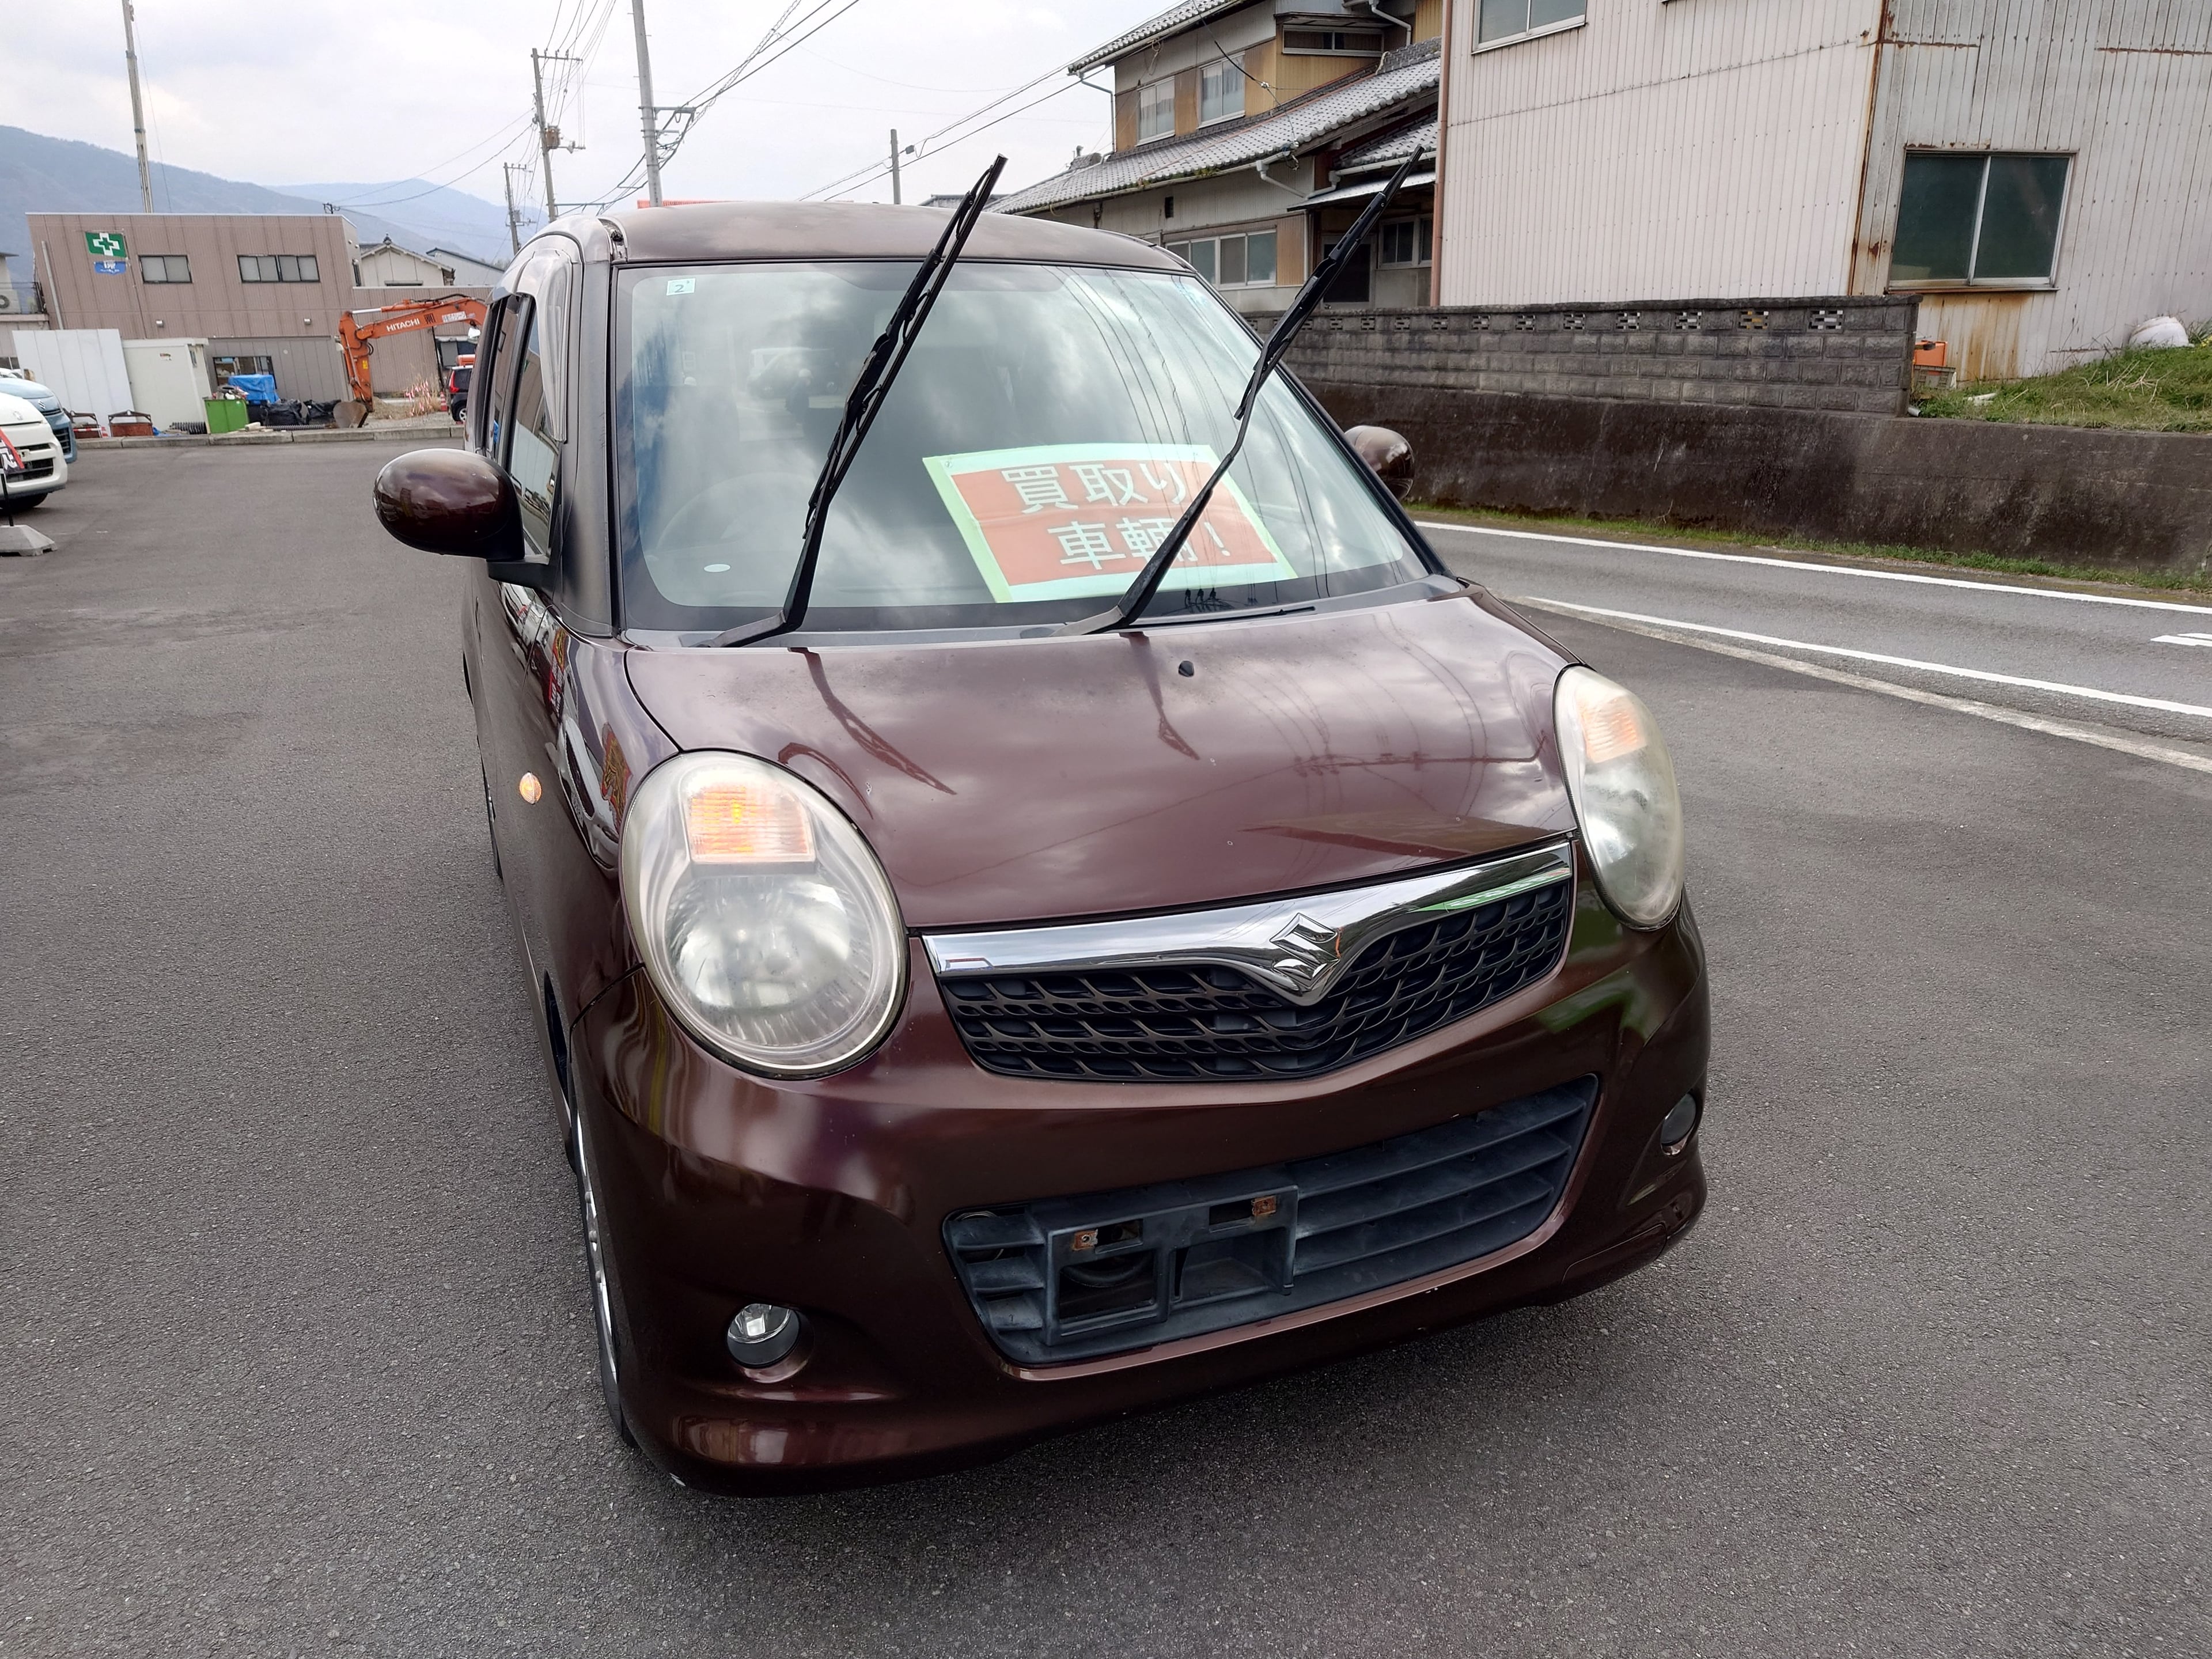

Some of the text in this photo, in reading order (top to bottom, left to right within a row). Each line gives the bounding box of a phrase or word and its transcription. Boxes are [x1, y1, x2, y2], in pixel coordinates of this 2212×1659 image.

[386, 317, 421, 332] HITACHI
[1001, 463, 1186, 514] 買取り
